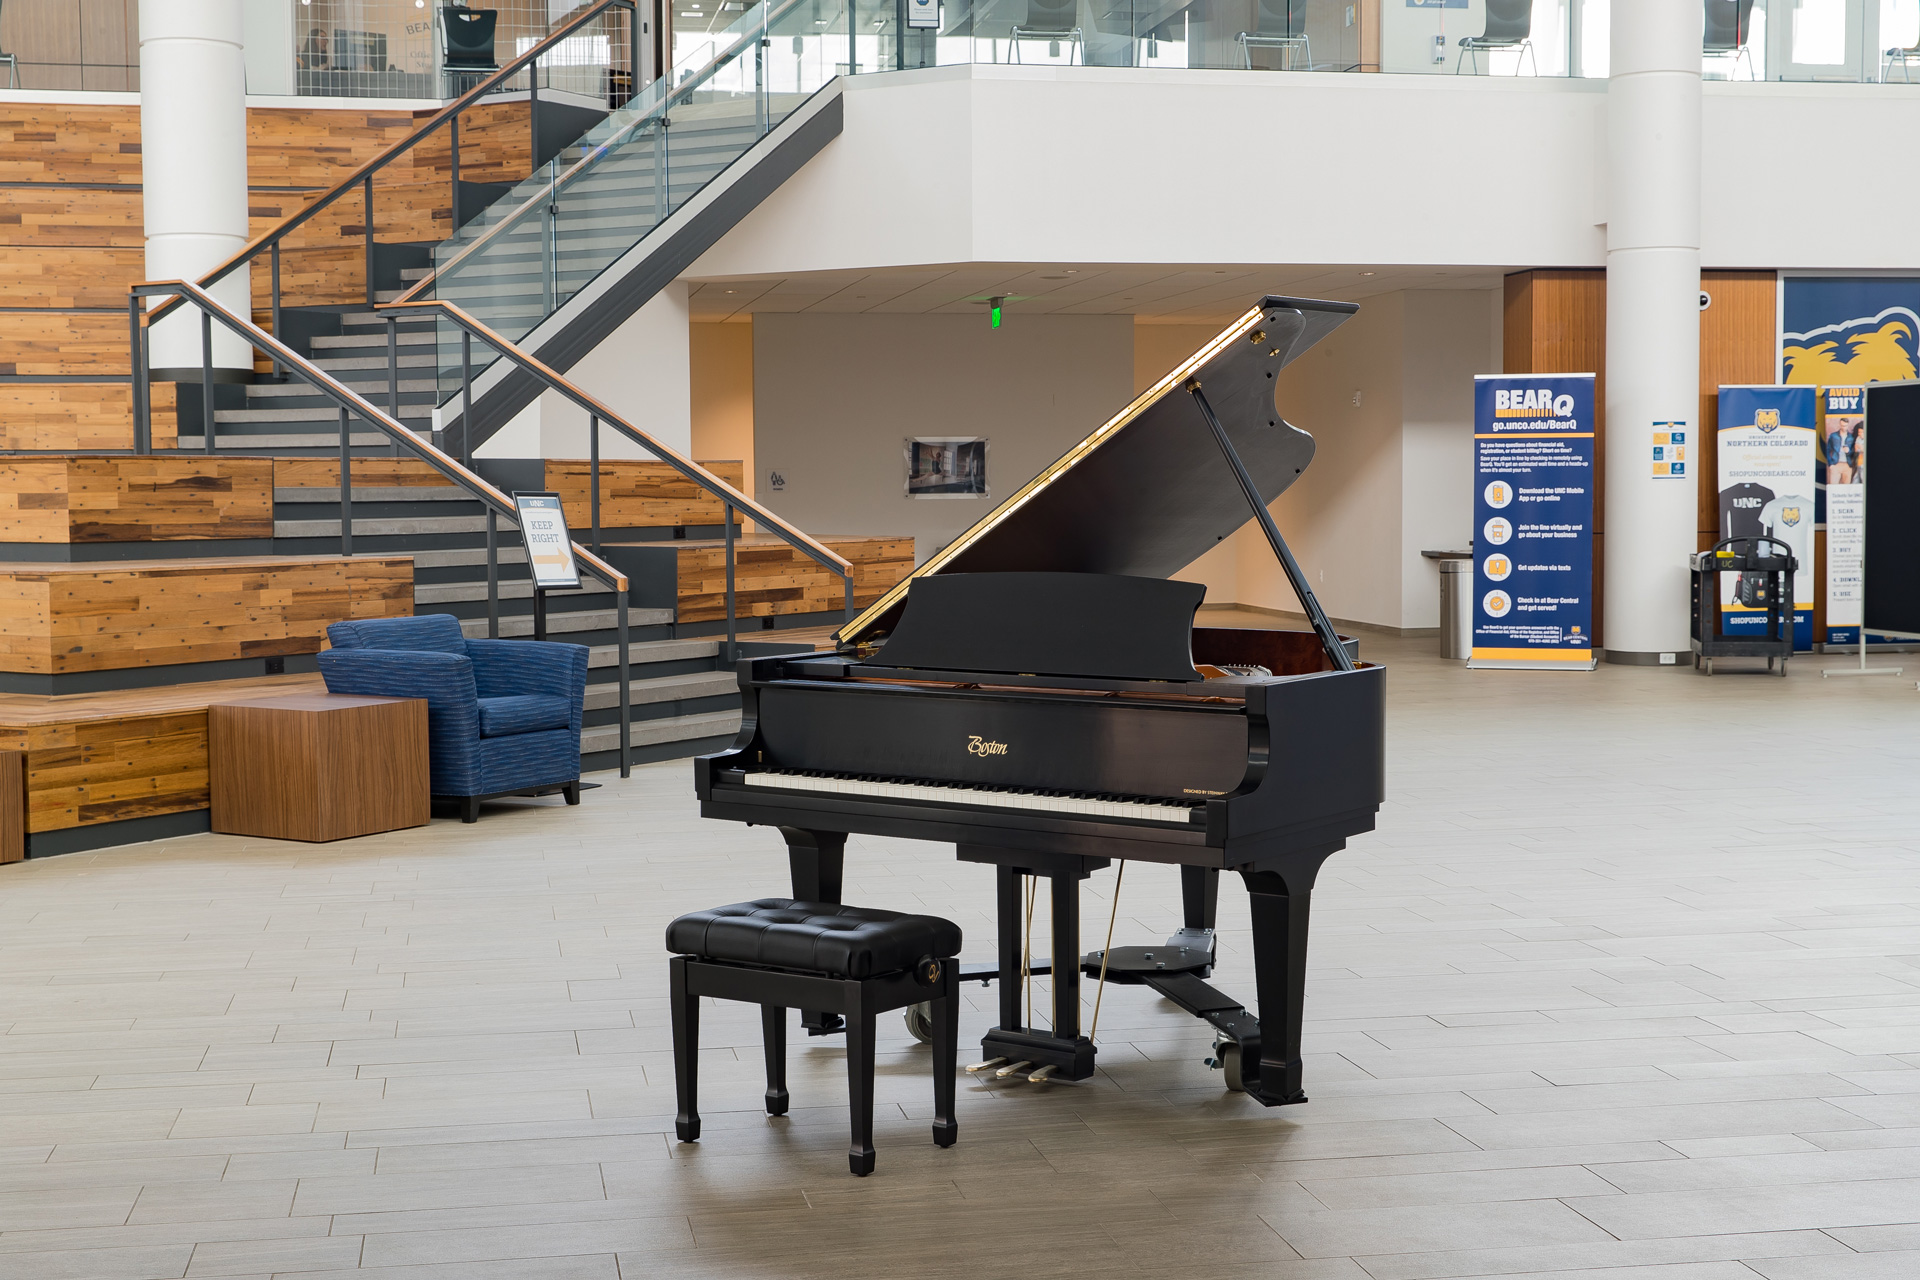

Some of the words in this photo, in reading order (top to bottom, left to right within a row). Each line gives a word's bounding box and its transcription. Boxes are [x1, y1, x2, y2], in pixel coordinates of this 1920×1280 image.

[406, 23, 431, 35] BEA
[1829, 388, 1860, 397] AVOID
[1829, 397, 1859, 410] BUY
[1492, 420, 1576, 432] go.unco.edu/BearQ
[529, 500, 544, 508] UNC
[1733, 497, 1762, 508] UNC
[530, 520, 553, 530] KEEP
[531, 533, 559, 543] RIGHT
[1722, 560, 1734, 568] UC
[968, 735, 1008, 757] Boston
